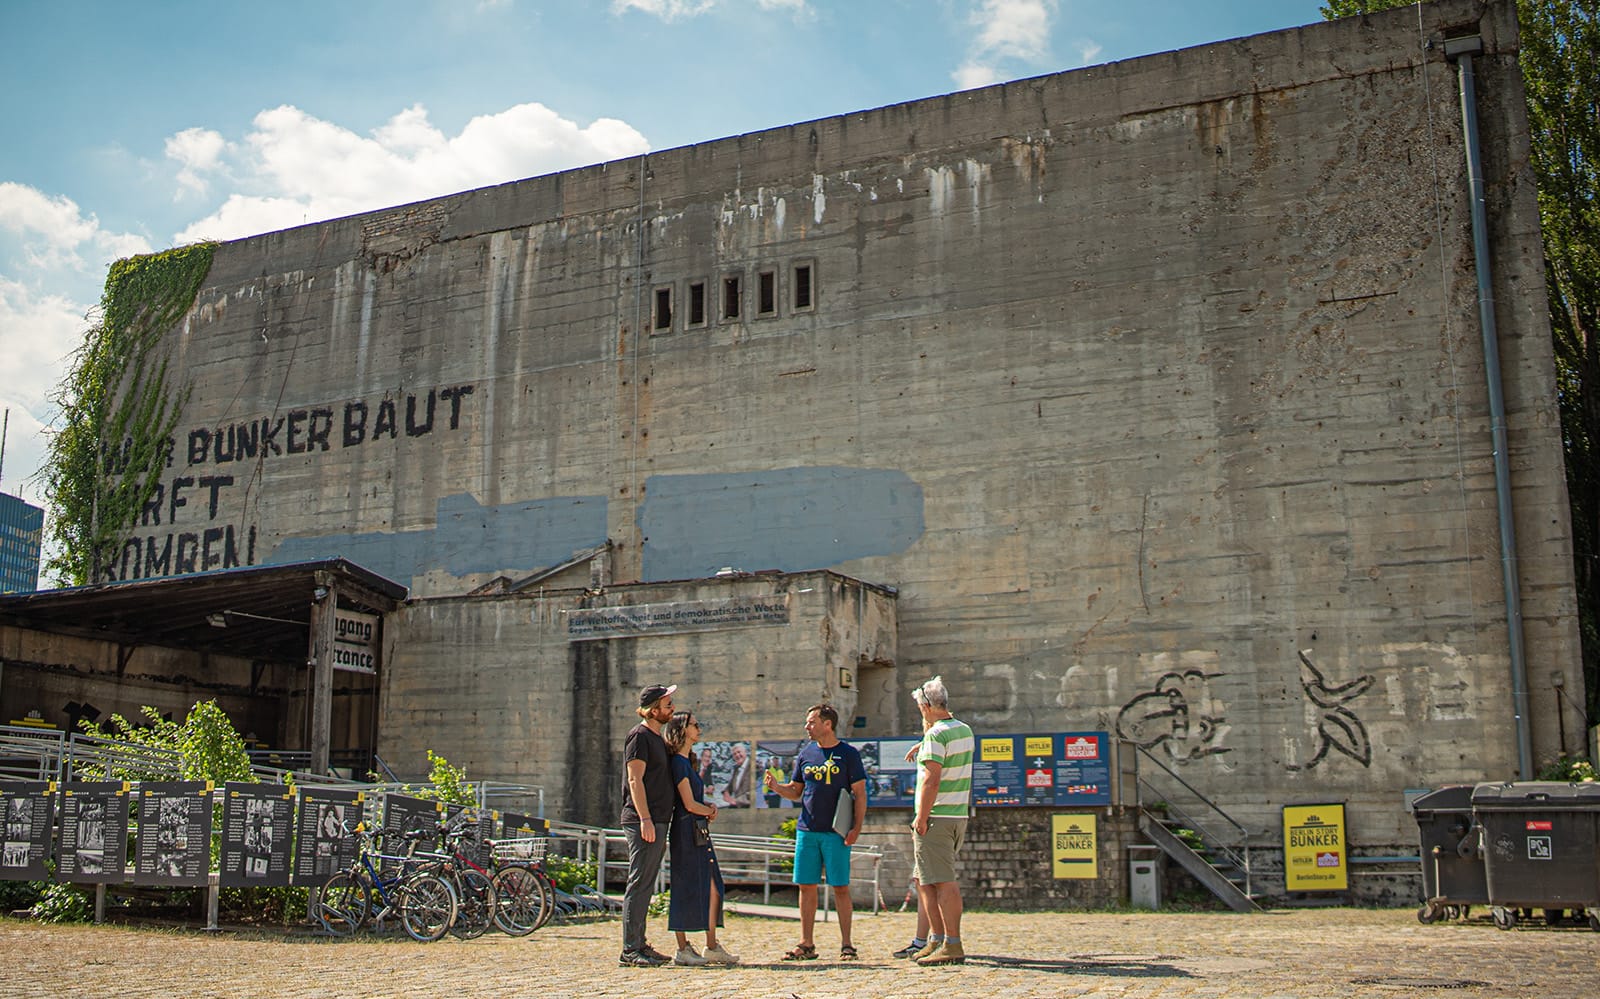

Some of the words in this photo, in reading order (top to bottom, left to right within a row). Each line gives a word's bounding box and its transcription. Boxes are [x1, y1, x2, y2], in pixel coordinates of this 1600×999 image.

[187, 408, 334, 467] BUNKER
[342, 384, 474, 448] BAUT
[653, 611, 672, 620] und
[674, 606, 751, 619] demokratische
[754, 602, 786, 613] Werte
[335, 617, 372, 641] gang
[983, 745, 1012, 753] HITLER
[1056, 840, 1094, 850] BUNKER
[1290, 834, 1339, 848] BUNKER
